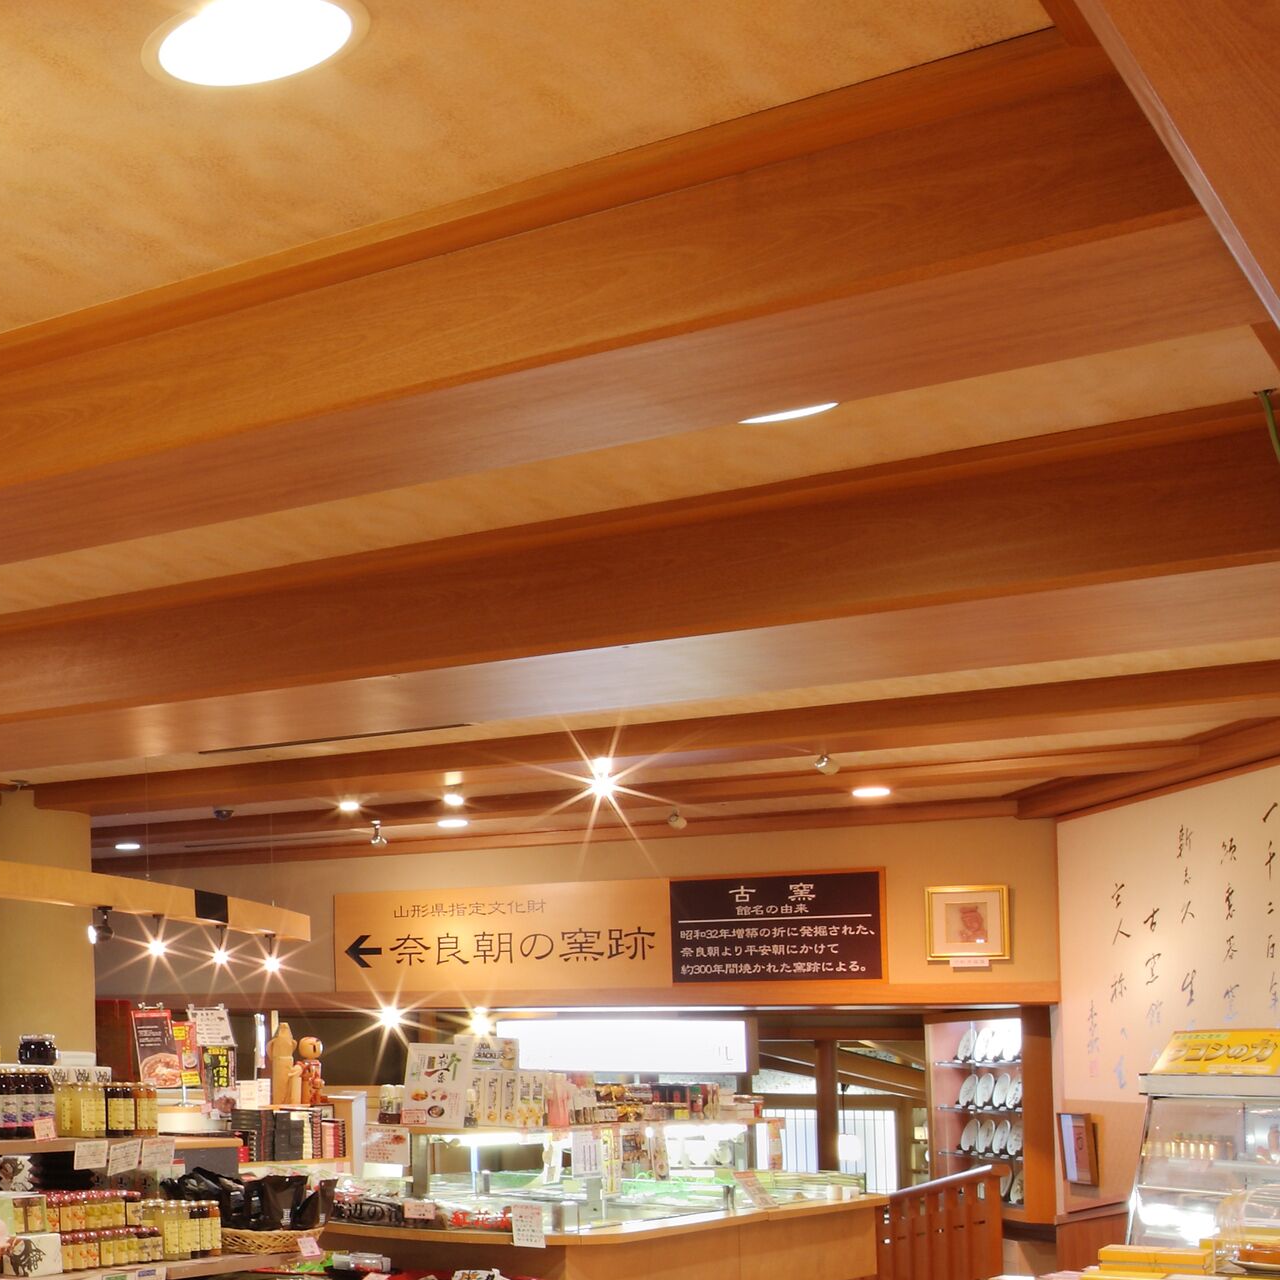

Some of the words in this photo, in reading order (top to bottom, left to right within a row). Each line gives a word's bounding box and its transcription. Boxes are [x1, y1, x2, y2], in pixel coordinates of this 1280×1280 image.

[393, 898, 547, 919] 山形県指定文化財
[736, 903, 810, 916] 館名の由来
[393, 925, 657, 966] 奈良朝の窯跡
[680, 943, 840, 958] 奈良朝より平安朝にかけて
